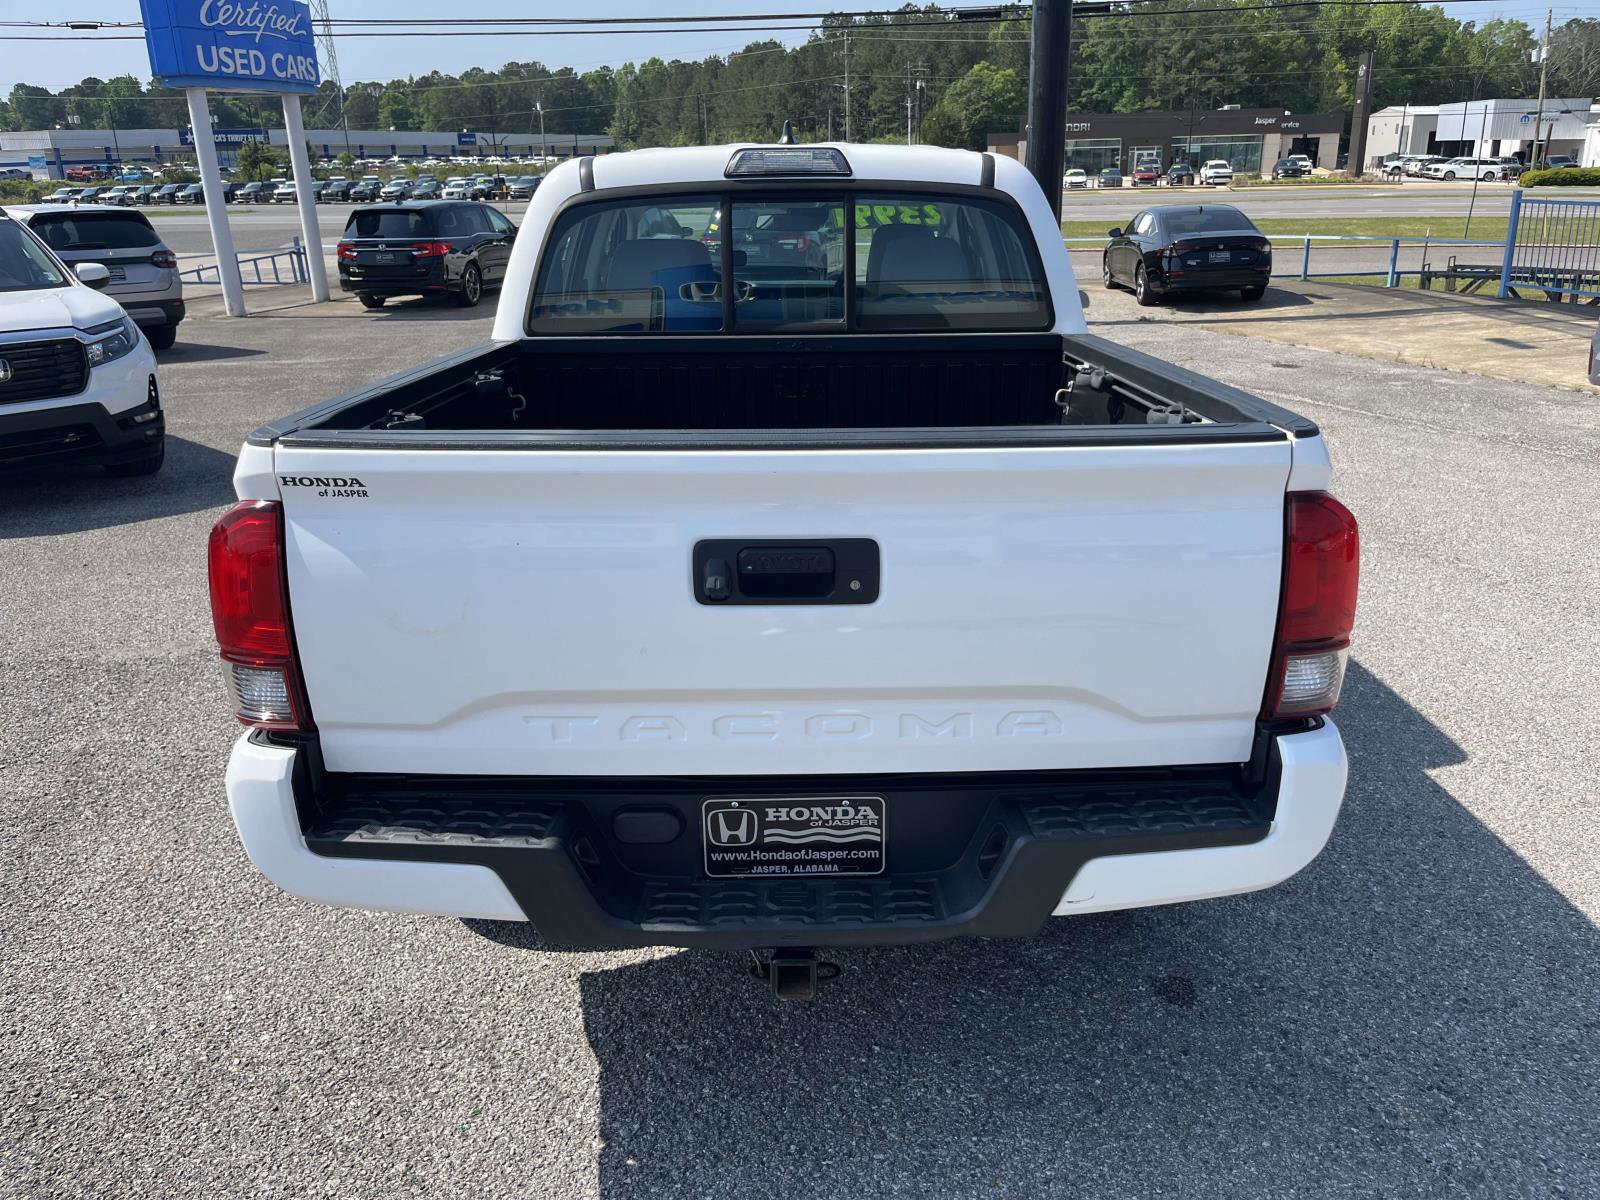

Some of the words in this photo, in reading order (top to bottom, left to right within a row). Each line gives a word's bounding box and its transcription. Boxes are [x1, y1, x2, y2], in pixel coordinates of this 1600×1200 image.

[200, 0, 306, 43] Certified
[196, 45, 266, 76] USED
[271, 53, 317, 82] CARS
[1254, 117, 1277, 126] Jasper
[1281, 121, 1300, 129] ervice
[280, 476, 367, 488] HONDA
[318, 488, 329, 497] of
[332, 489, 370, 498] JASPER
[522, 711, 1065, 743] TACOMA
[765, 806, 879, 821] HONDA
[810, 819, 823, 827] of
[824, 819, 878, 827] JASPER
[711, 850, 880, 862] www.HondaofJasper.com
[751, 865, 791, 874] JASPER,
[793, 864, 839, 873] ALABAMA
